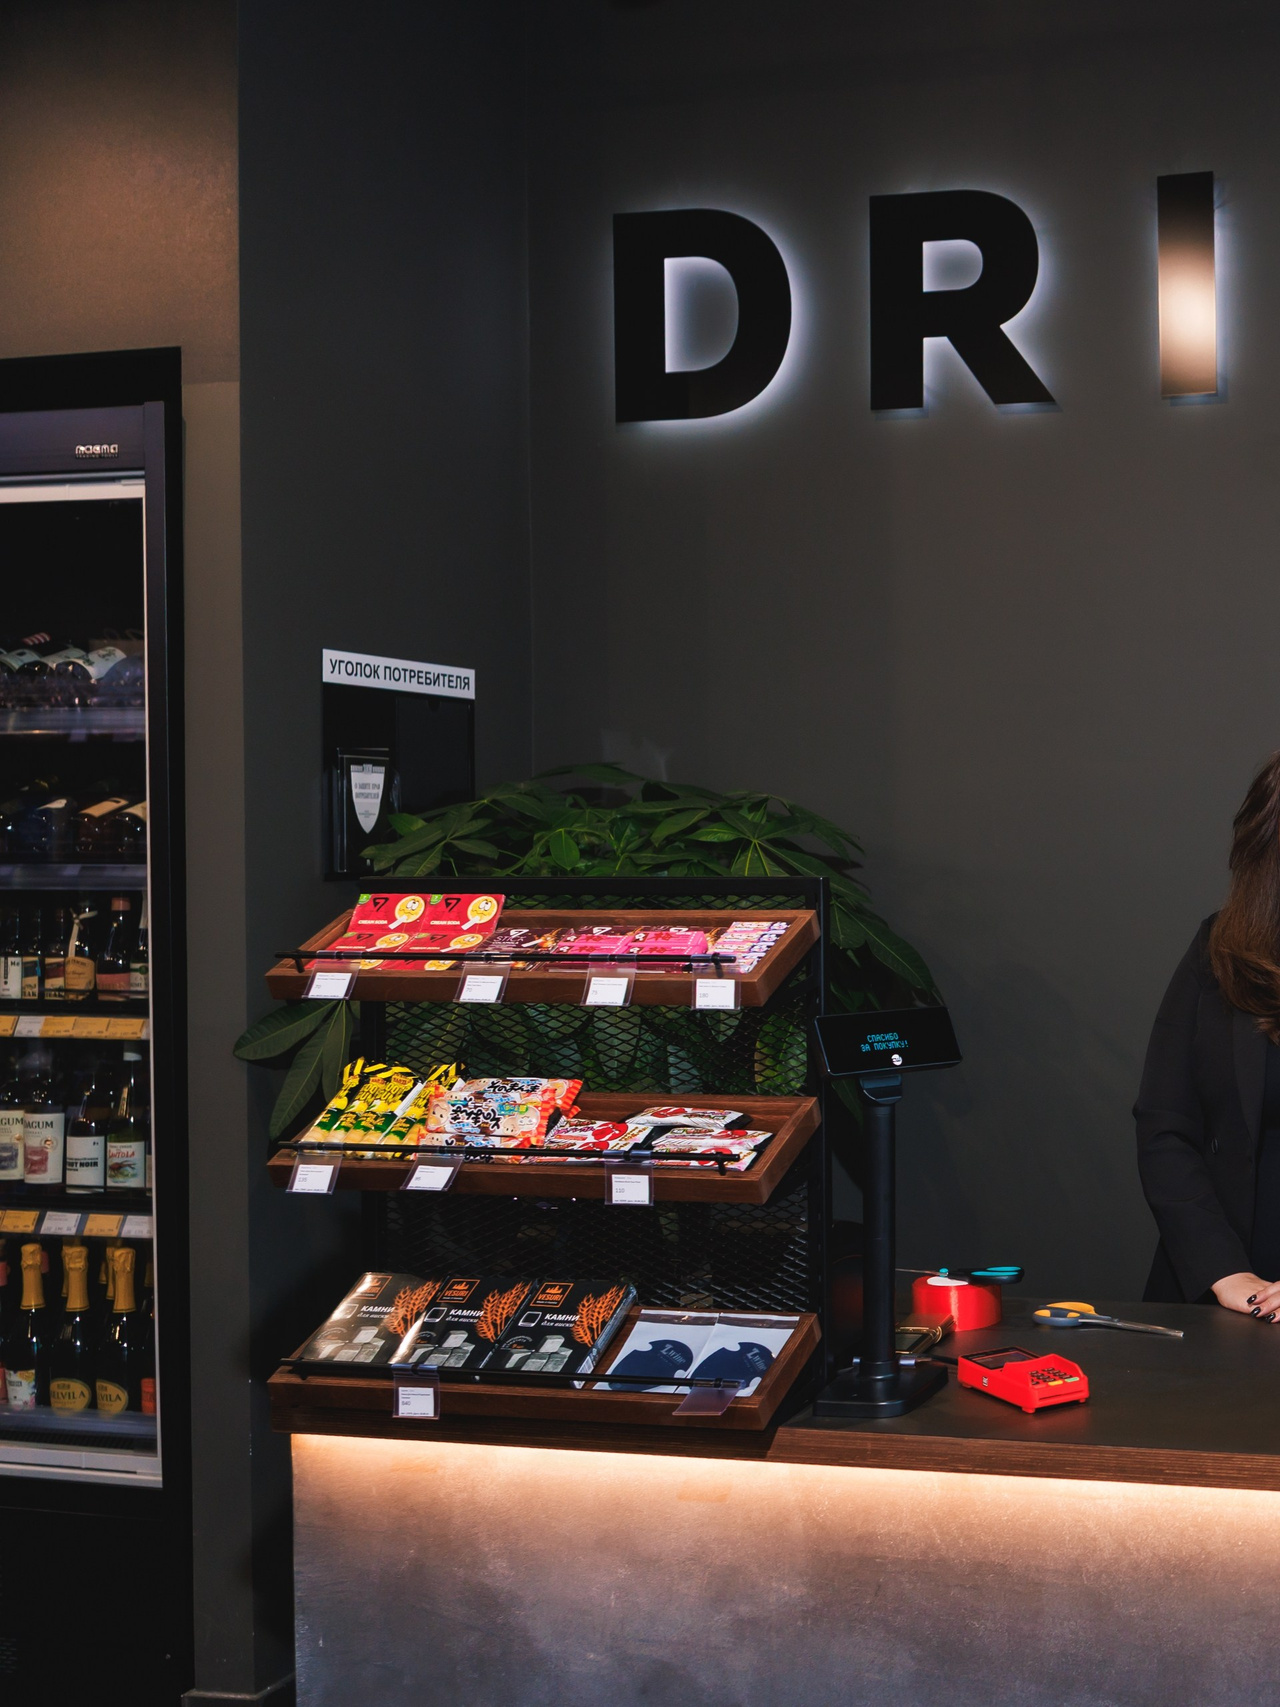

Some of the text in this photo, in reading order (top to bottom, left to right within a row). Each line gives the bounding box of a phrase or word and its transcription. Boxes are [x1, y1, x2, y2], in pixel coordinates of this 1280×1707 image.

[329, 658, 471, 691] УГОЛОК ПОТРЕБИТЕЛЯ
[866, 1032, 899, 1043] СПАСИБО
[860, 1040, 909, 1052] ЗА ПОКУПКУ!
[360, 1305, 396, 1313] КАМНИ
[449, 1308, 485, 1317] КАМНИ
[544, 1313, 580, 1322] КАМНИ
